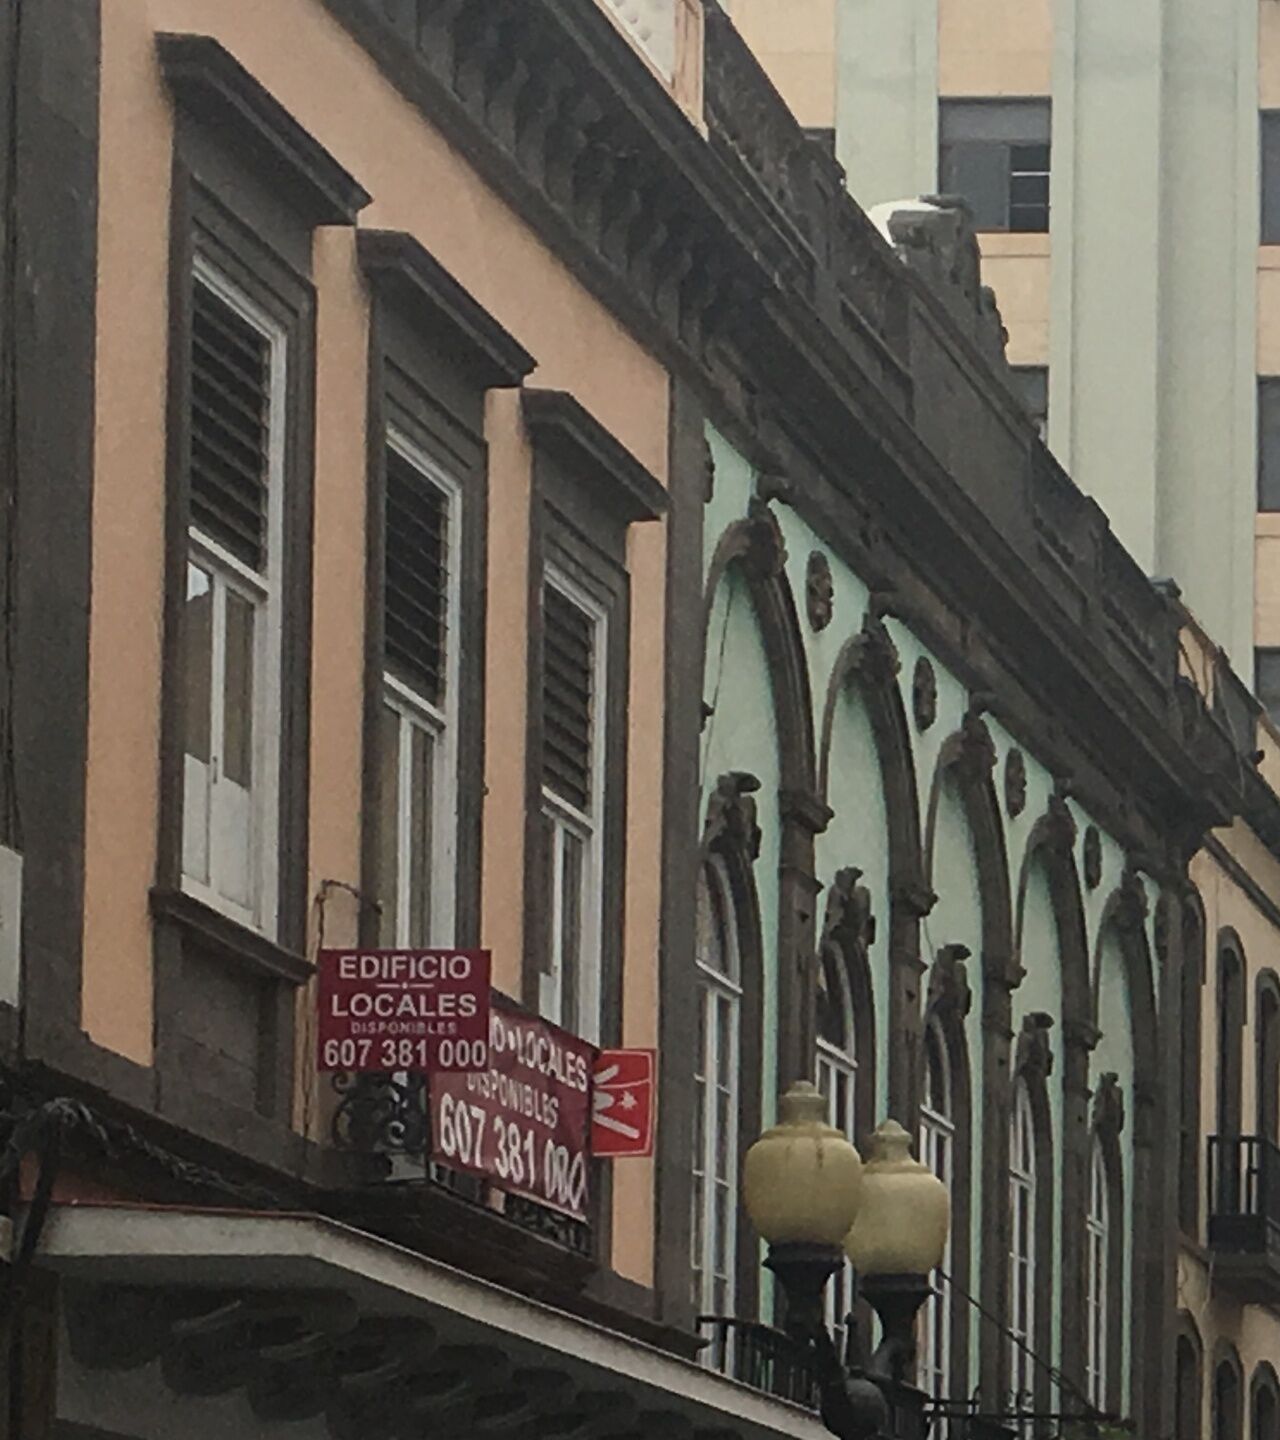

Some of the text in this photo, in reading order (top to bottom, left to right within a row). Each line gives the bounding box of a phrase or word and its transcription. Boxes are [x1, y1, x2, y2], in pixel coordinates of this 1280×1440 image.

[339, 955, 472, 980] EDIFICIO
[331, 993, 477, 1018] LOCALES
[351, 1021, 457, 1035] DISPONIBLES
[323, 1039, 488, 1068] 607 381 000
[516, 1025, 588, 1092] LOCALES
[439, 1092, 486, 1168] 607
[493, 1115, 536, 1189] 381
